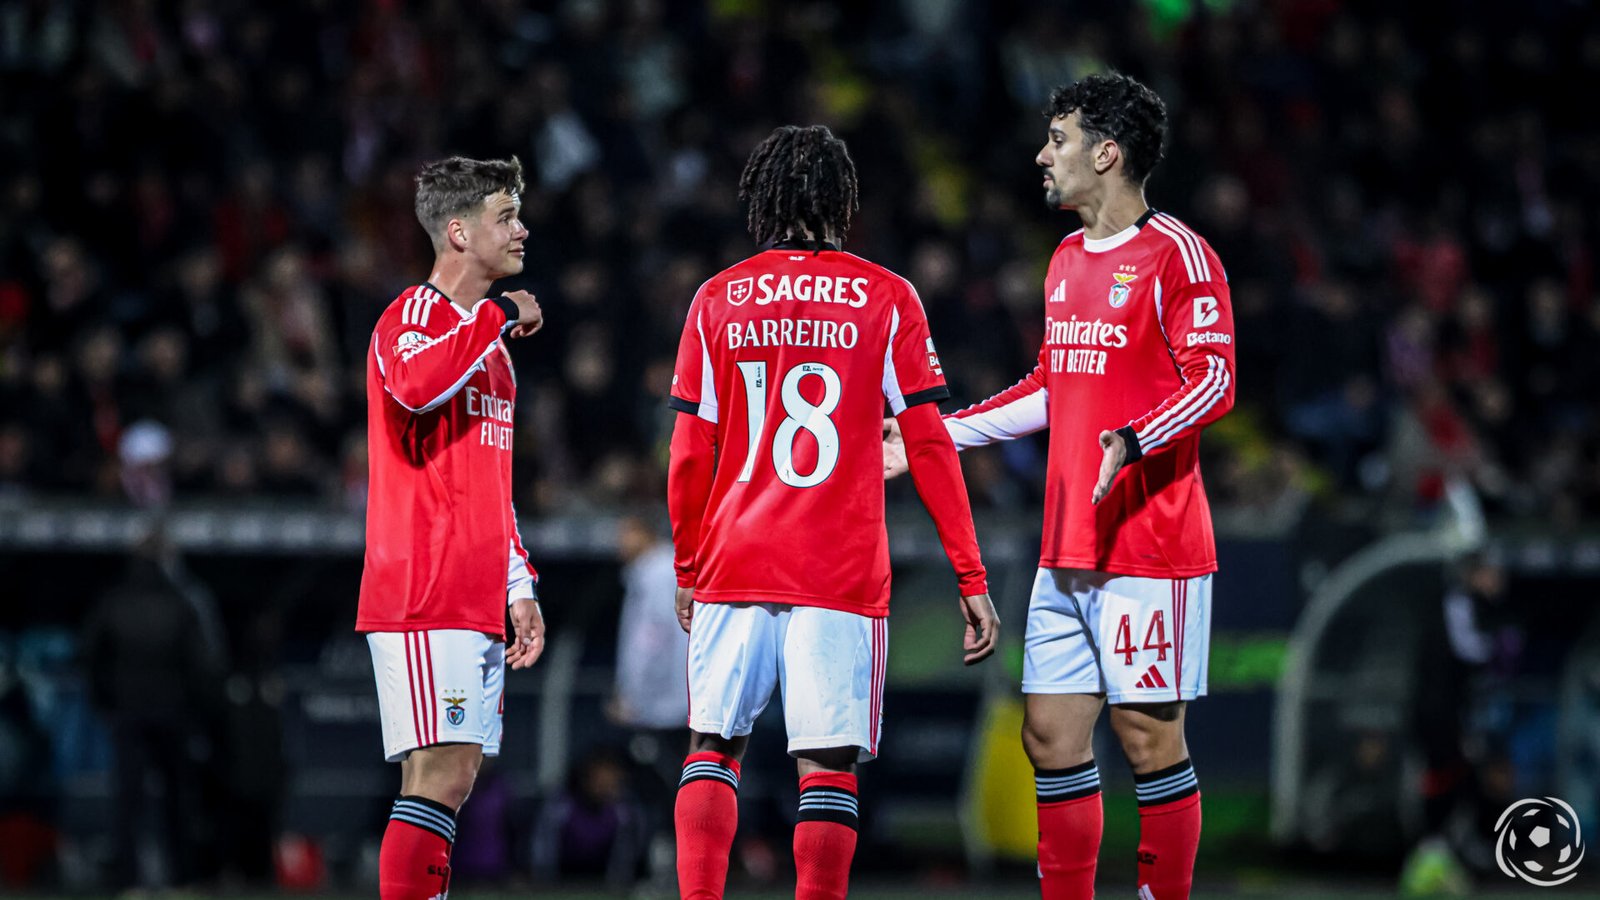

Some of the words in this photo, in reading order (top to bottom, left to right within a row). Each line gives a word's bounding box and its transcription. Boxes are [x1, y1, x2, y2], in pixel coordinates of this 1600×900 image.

[755, 273, 869, 309] SAGRES
[727, 318, 859, 350] BARREIRO
[1046, 314, 1128, 348] Emirates
[1187, 330, 1232, 347] Betano
[1051, 349, 1066, 374] FLY
[1066, 349, 1108, 375] BETTER
[735, 360, 843, 489] 18
[1113, 609, 1173, 666] 44
